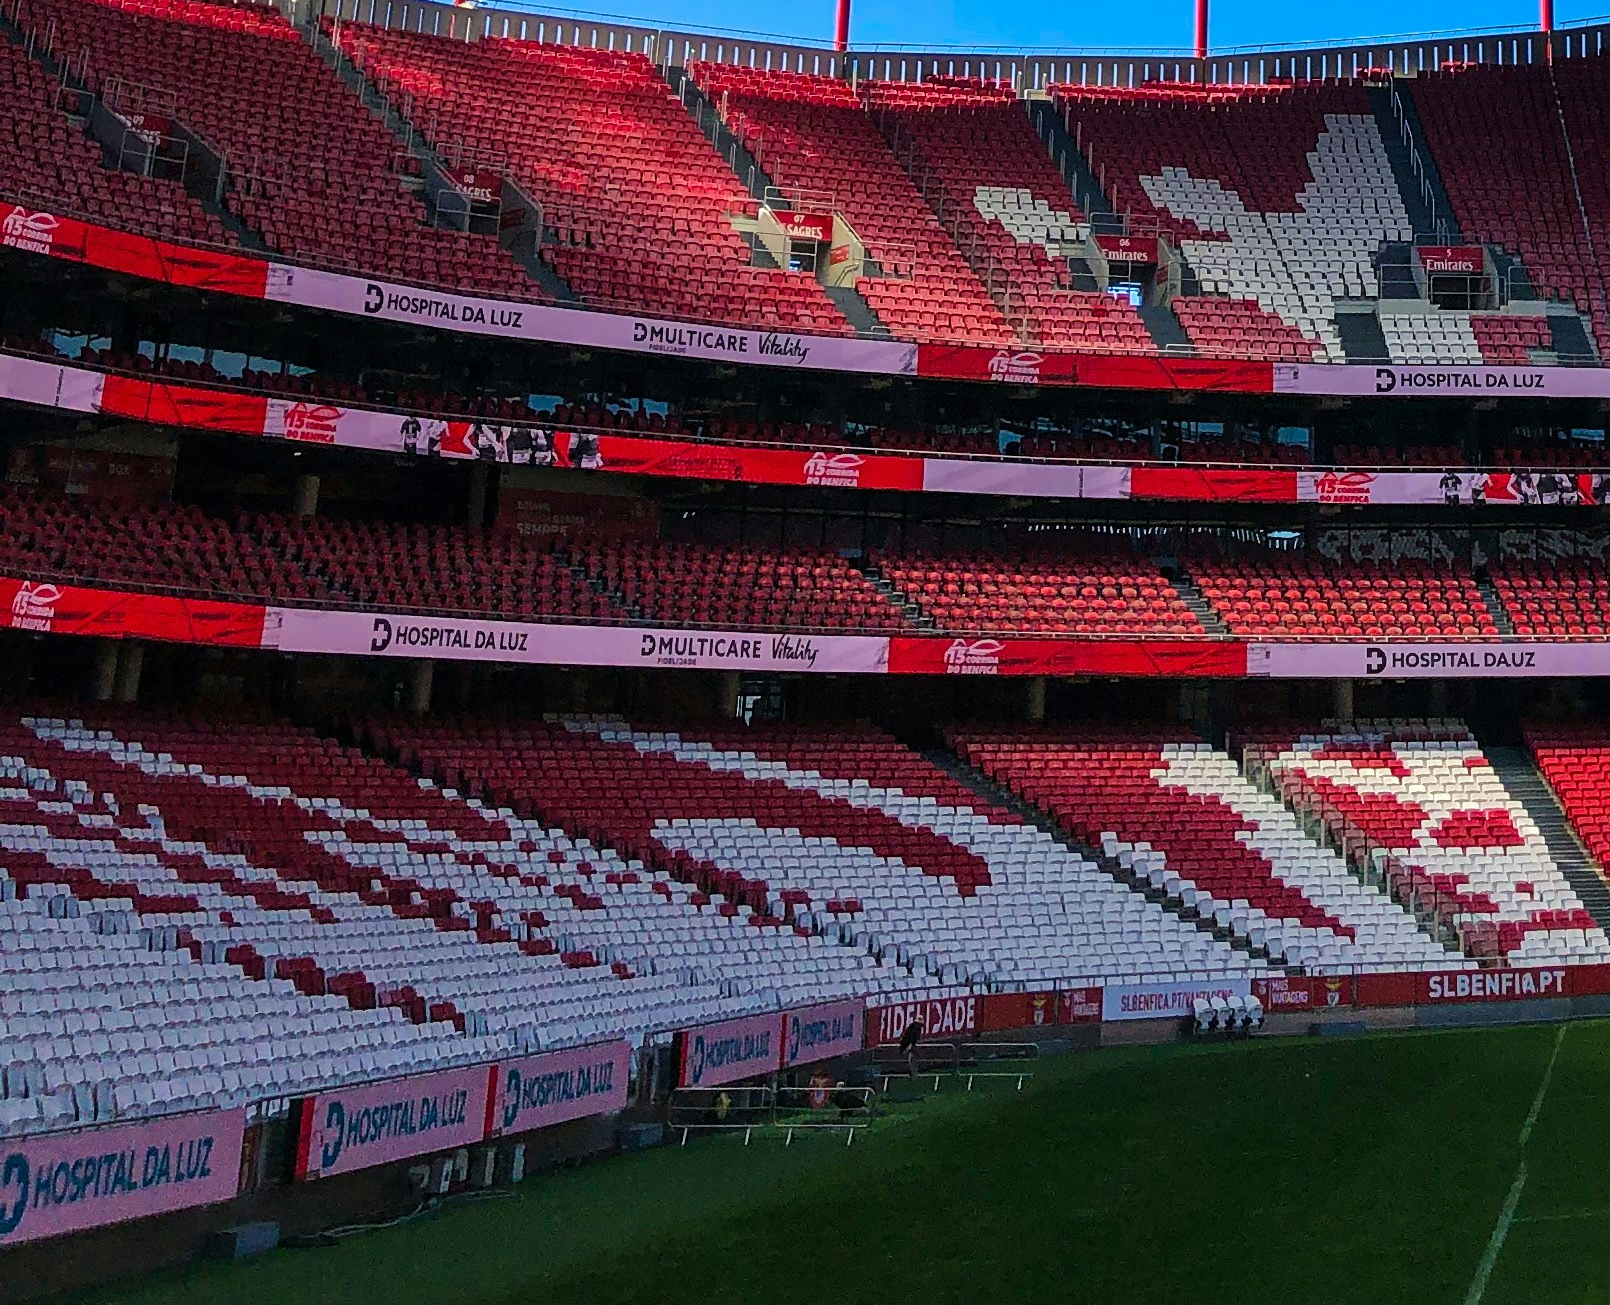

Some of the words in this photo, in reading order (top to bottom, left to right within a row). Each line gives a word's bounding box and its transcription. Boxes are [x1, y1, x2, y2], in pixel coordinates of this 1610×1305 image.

[793, 215, 806, 224] 07
[786, 224, 823, 240] SAGRES
[1119, 238, 1130, 247] 06
[1102, 249, 1148, 262] Emirates
[1426, 259, 1474, 272] Emirates
[387, 293, 458, 321] HOSPITAL
[460, 306, 485, 324] DA
[490, 309, 523, 328] LUZ
[649, 326, 747, 353] MULTICARE
[757, 333, 810, 363] Vitality
[1401, 373, 1481, 388] HOSPITAL
[1485, 374, 1510, 388] DA
[1514, 375, 1545, 388] LUZ
[396, 626, 471, 648] HOSPITAL
[474, 631, 495, 649] DA
[500, 632, 528, 651] LUZ
[660, 637, 761, 659] MULTICARE
[772, 635, 819, 669] Vitality
[1392, 653, 1479, 668] HOSPITAL
[522, 1071, 575, 1108] HOSPITAL
[576, 1071, 592, 1099] DA
[592, 1061, 614, 1095] LUZ
[346, 1103, 416, 1145] HOSPITAL
[418, 1100, 439, 1129] DA
[440, 1089, 467, 1127] LUZ
[31, 1149, 138, 1209] HOSPITAL
[142, 1145, 172, 1185] DA
[175, 1135, 214, 1183] LUZ
